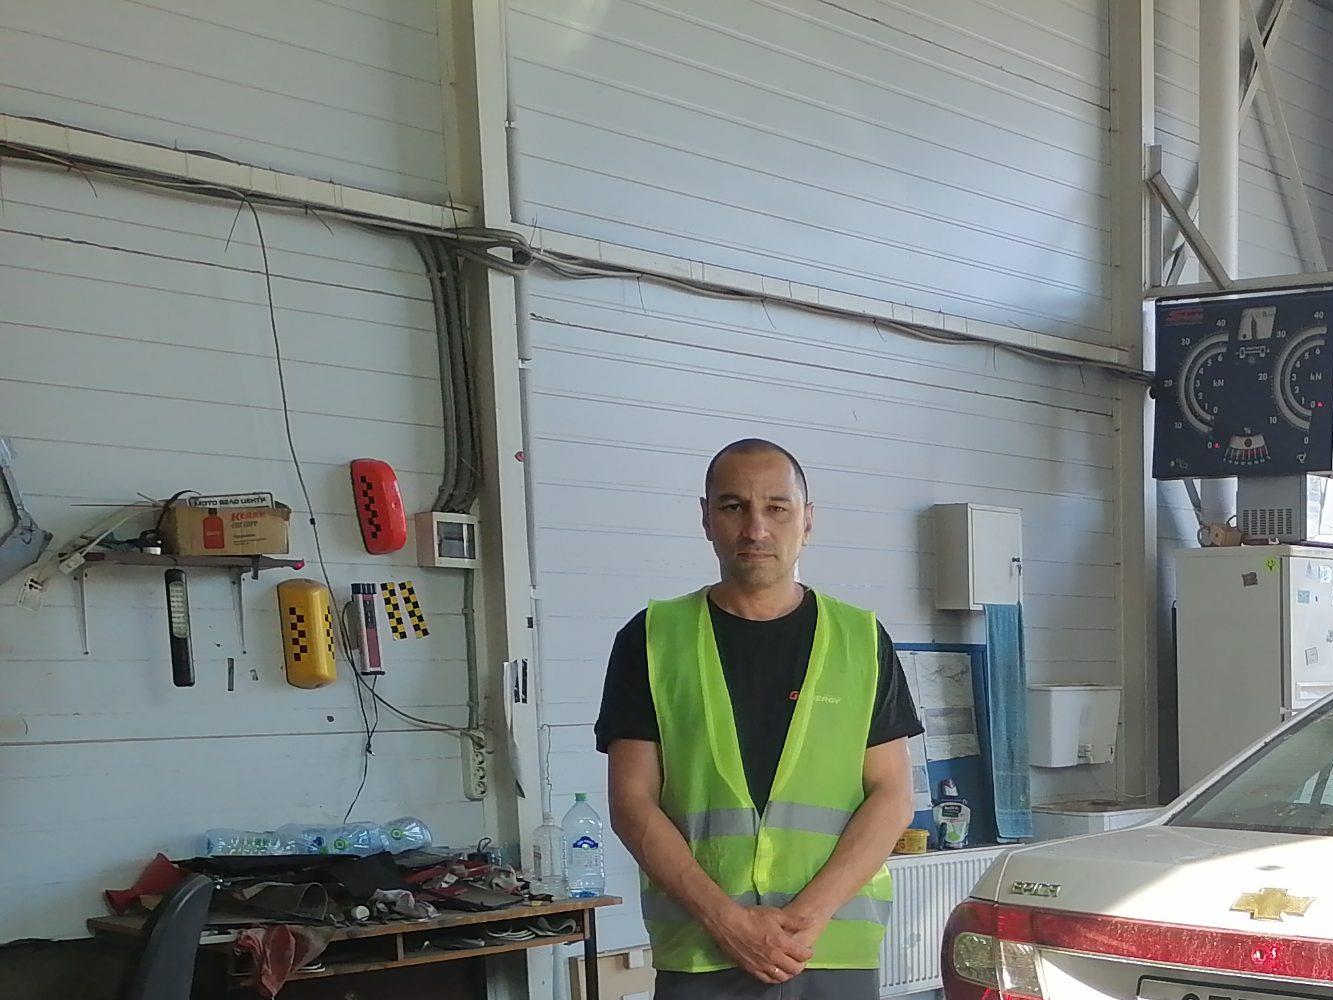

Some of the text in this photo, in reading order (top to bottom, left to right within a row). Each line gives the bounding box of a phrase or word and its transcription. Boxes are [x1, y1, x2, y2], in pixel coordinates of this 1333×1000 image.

[1313, 311, 1324, 319] 40
[1216, 319, 1226, 327] 40
[1276, 330, 1286, 338] 30
[1310, 372, 1322, 380] kN
[1164, 379, 1173, 387] 20
[1213, 379, 1224, 387] kN
[1269, 416, 1277, 424] 10
